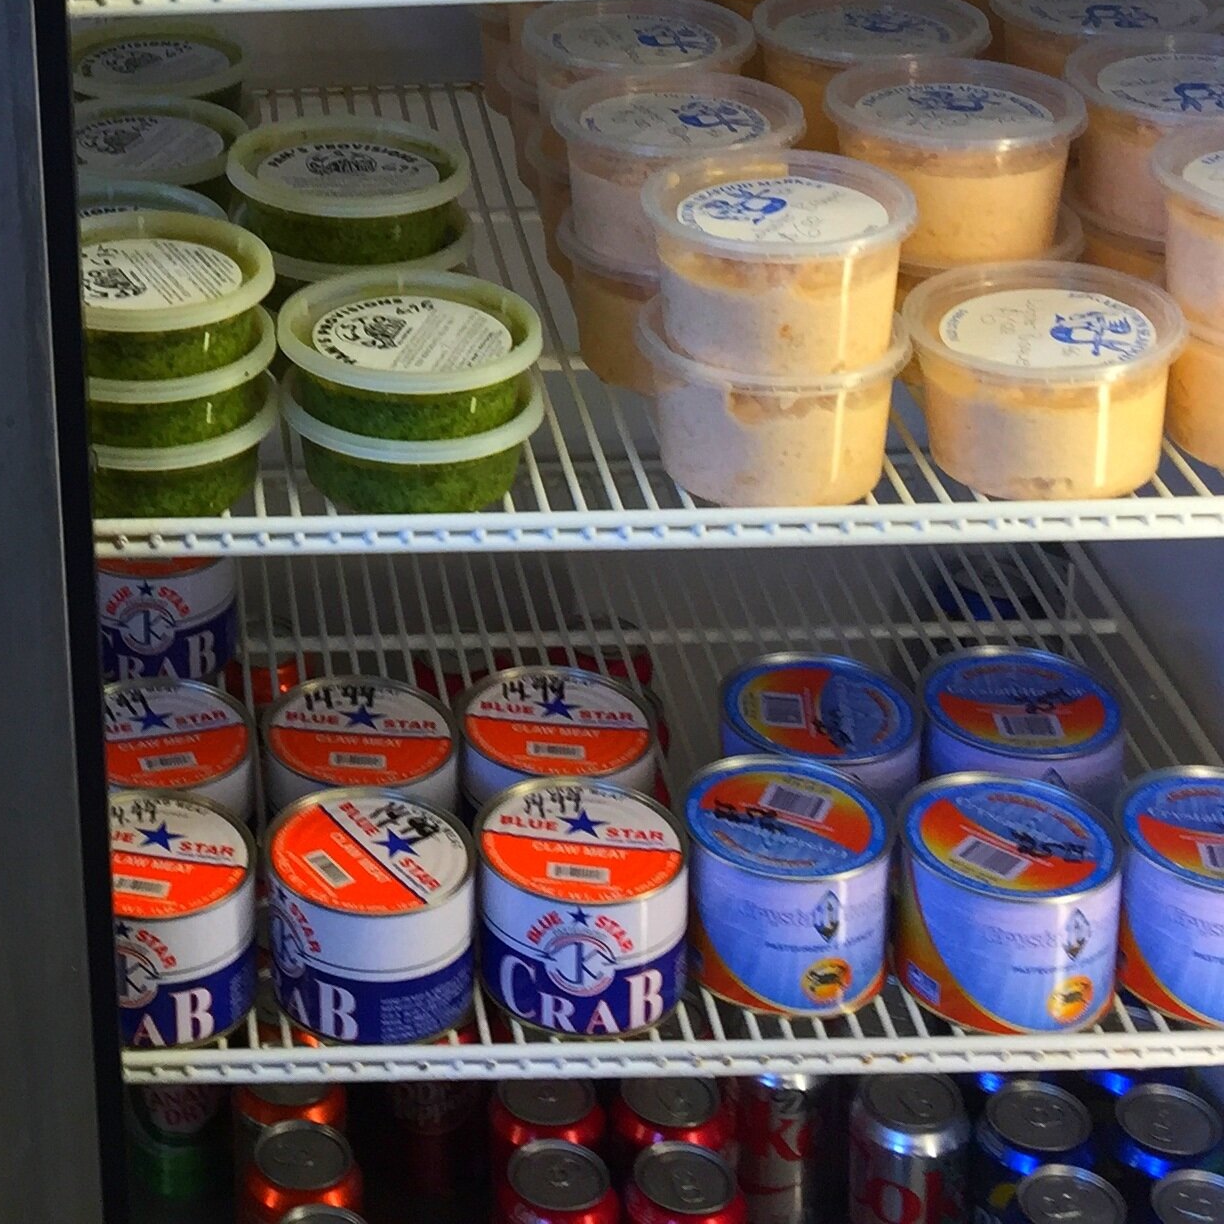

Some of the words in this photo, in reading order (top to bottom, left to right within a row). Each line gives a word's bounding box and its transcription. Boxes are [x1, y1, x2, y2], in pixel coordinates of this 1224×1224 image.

[105, 585, 132, 616] BLUE
[157, 585, 192, 617] STAR
[102, 630, 217, 680] RAB
[173, 708, 229, 727] STAR
[285, 710, 340, 726] BLUE
[382, 717, 438, 732] STAR
[480, 700, 535, 716] BLUE
[578, 709, 635, 723] STAR
[111, 797, 158, 827] 4.99
[499, 813, 560, 833] BLUE
[605, 826, 666, 843] STAR
[113, 853, 151, 869] LAW
[178, 840, 237, 858] STAR
[338, 801, 383, 837] BLUE
[398, 856, 443, 893] STAR
[531, 839, 579, 854] CLAW
[582, 843, 628, 859] MEAT
[527, 910, 564, 944] BLUE
[595, 914, 634, 952] STAR
[135, 928, 178, 969] STAR
[283, 978, 360, 1041] AB
[499, 954, 665, 1036] CRAB
[133, 987, 216, 1048] AB
